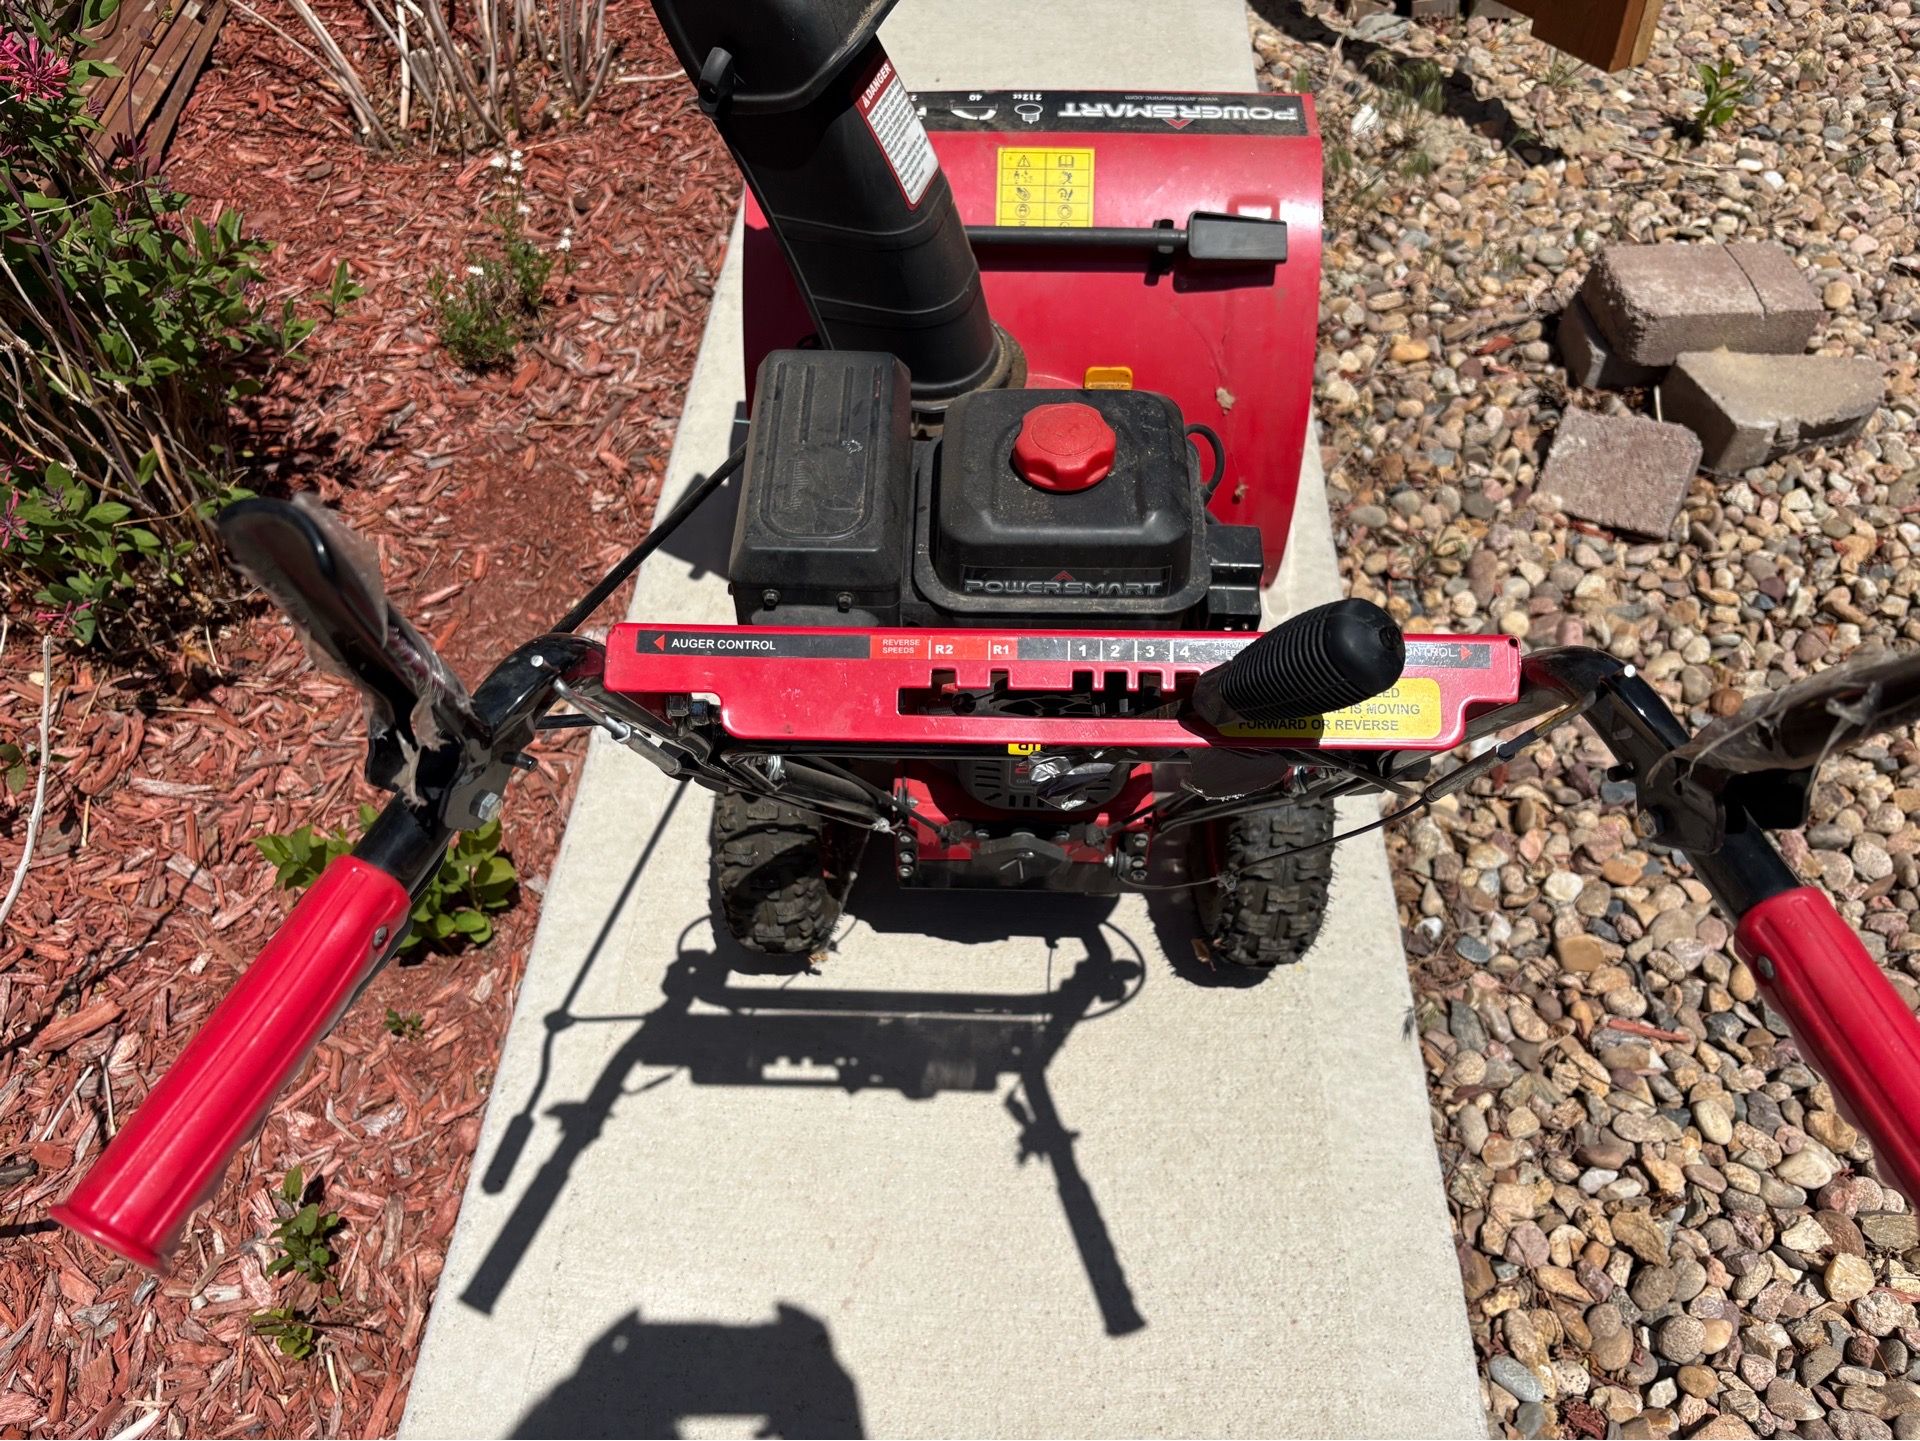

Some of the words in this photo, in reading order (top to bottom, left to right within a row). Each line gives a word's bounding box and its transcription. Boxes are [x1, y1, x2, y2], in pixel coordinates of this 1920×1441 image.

[866, 63, 892, 100] DANGER
[1057, 102, 1298, 121] POWERSMART
[965, 580, 1161, 595] POWERSMART
[671, 638, 715, 650] AUGER
[717, 639, 776, 650] CONTROL
[882, 638, 921, 647] REVERSE
[882, 646, 915, 654] SPEEDS
[935, 644, 954, 655] R2
[993, 644, 1010, 655] R1
[1078, 644, 1087, 657] 1
[1110, 645, 1120, 658] 2
[1145, 645, 1155, 658] 3
[1179, 646, 1190, 658] 4
[1405, 647, 1458, 657] ONTROL
[1350, 704, 1362, 714] IS
[1367, 704, 1420, 715] MOVING
[1311, 719, 1331, 730] OR
[1335, 720, 1399, 731] REVERSE
